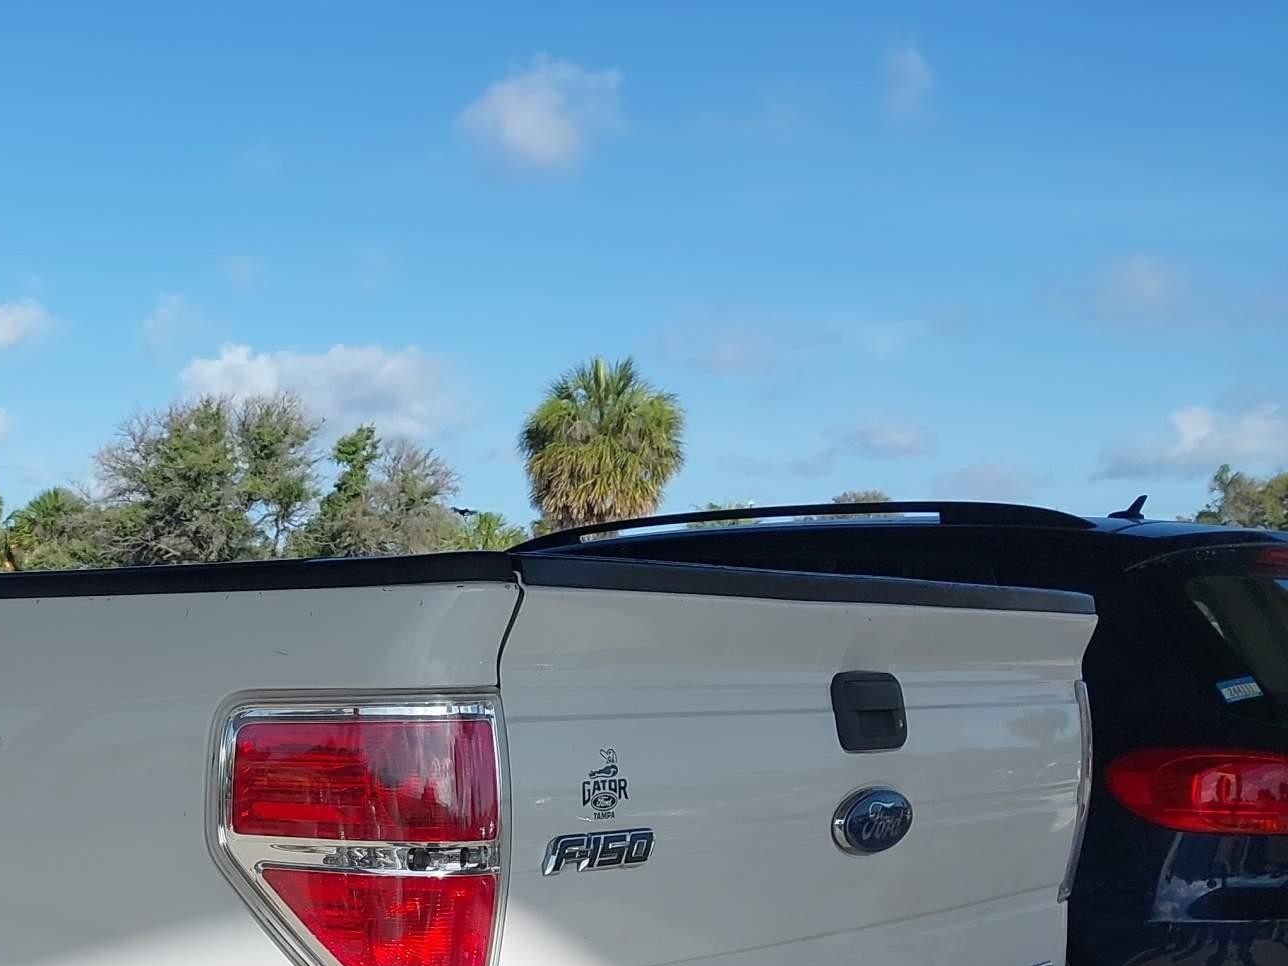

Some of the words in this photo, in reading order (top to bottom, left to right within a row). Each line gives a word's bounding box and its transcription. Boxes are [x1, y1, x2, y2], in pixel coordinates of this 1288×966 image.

[582, 778, 629, 807] GATOR
[593, 811, 616, 820] TAMPA
[862, 801, 906, 841] Ford
